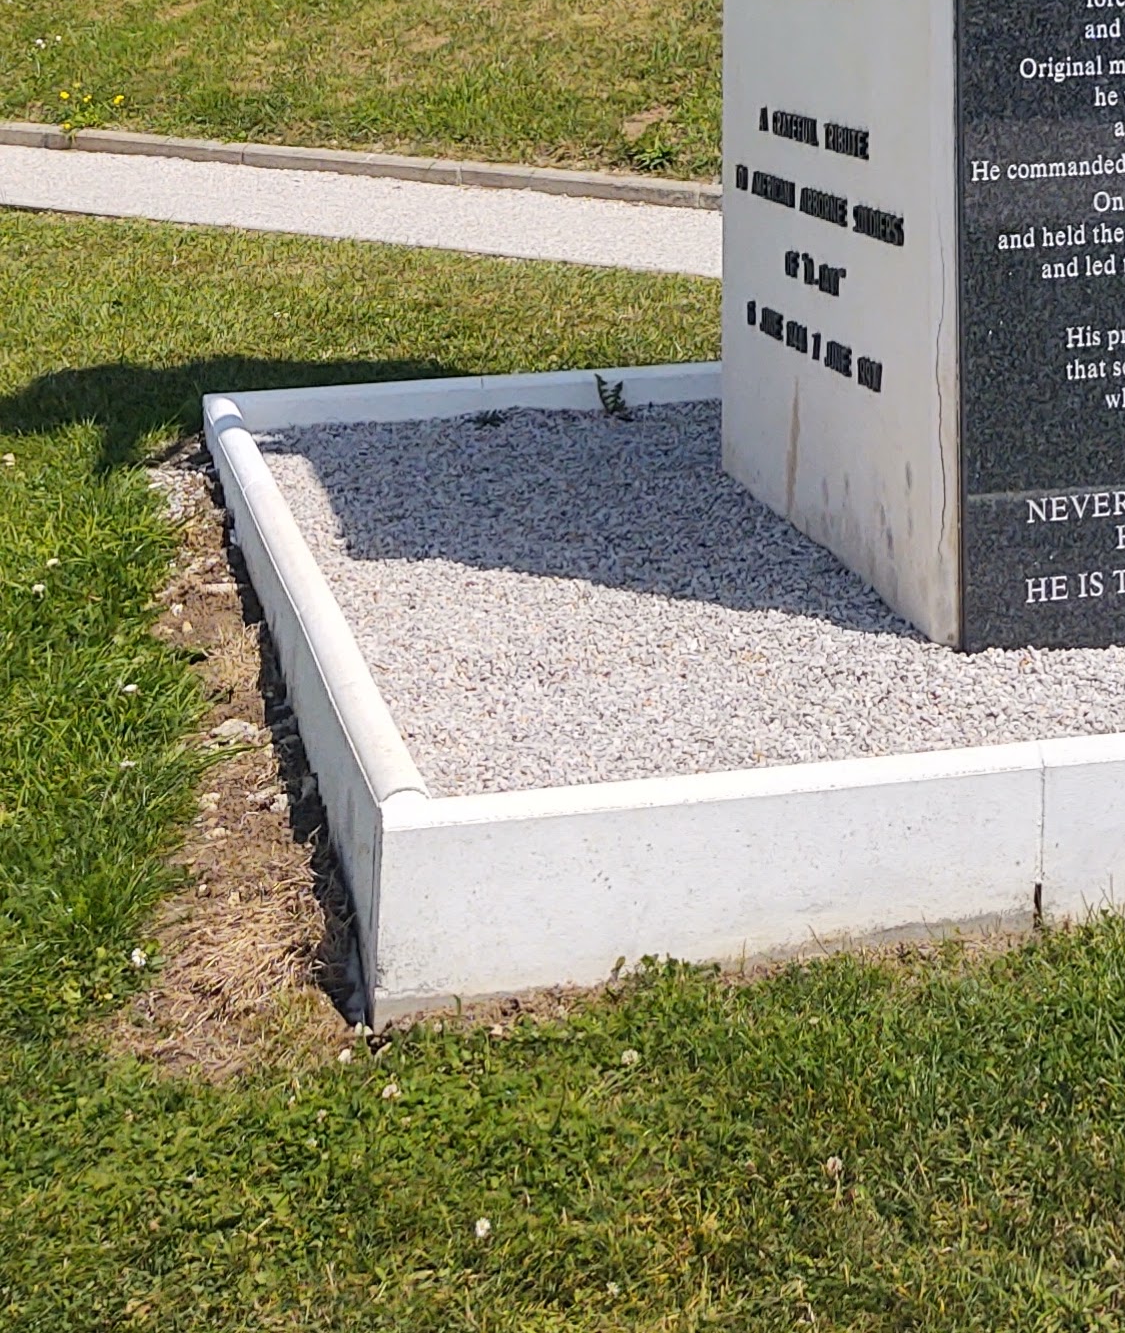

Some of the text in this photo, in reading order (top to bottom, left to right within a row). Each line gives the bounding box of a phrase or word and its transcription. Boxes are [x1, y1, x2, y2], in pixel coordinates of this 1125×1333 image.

[1084, 17, 1121, 39] and
[1019, 54, 1103, 83] Original
[1093, 85, 1119, 107] he
[970, 160, 1001, 182] He
[1093, 191, 1125, 213] On
[997, 226, 1036, 250] and
[1041, 222, 1086, 247] held
[1092, 222, 1125, 244] the
[1041, 256, 1079, 279] and
[1085, 253, 1117, 277] led
[1065, 325, 1101, 349] His
[1065, 358, 1107, 381] that
[1025, 575, 1069, 604] HE
[1077, 571, 1104, 598] IS
